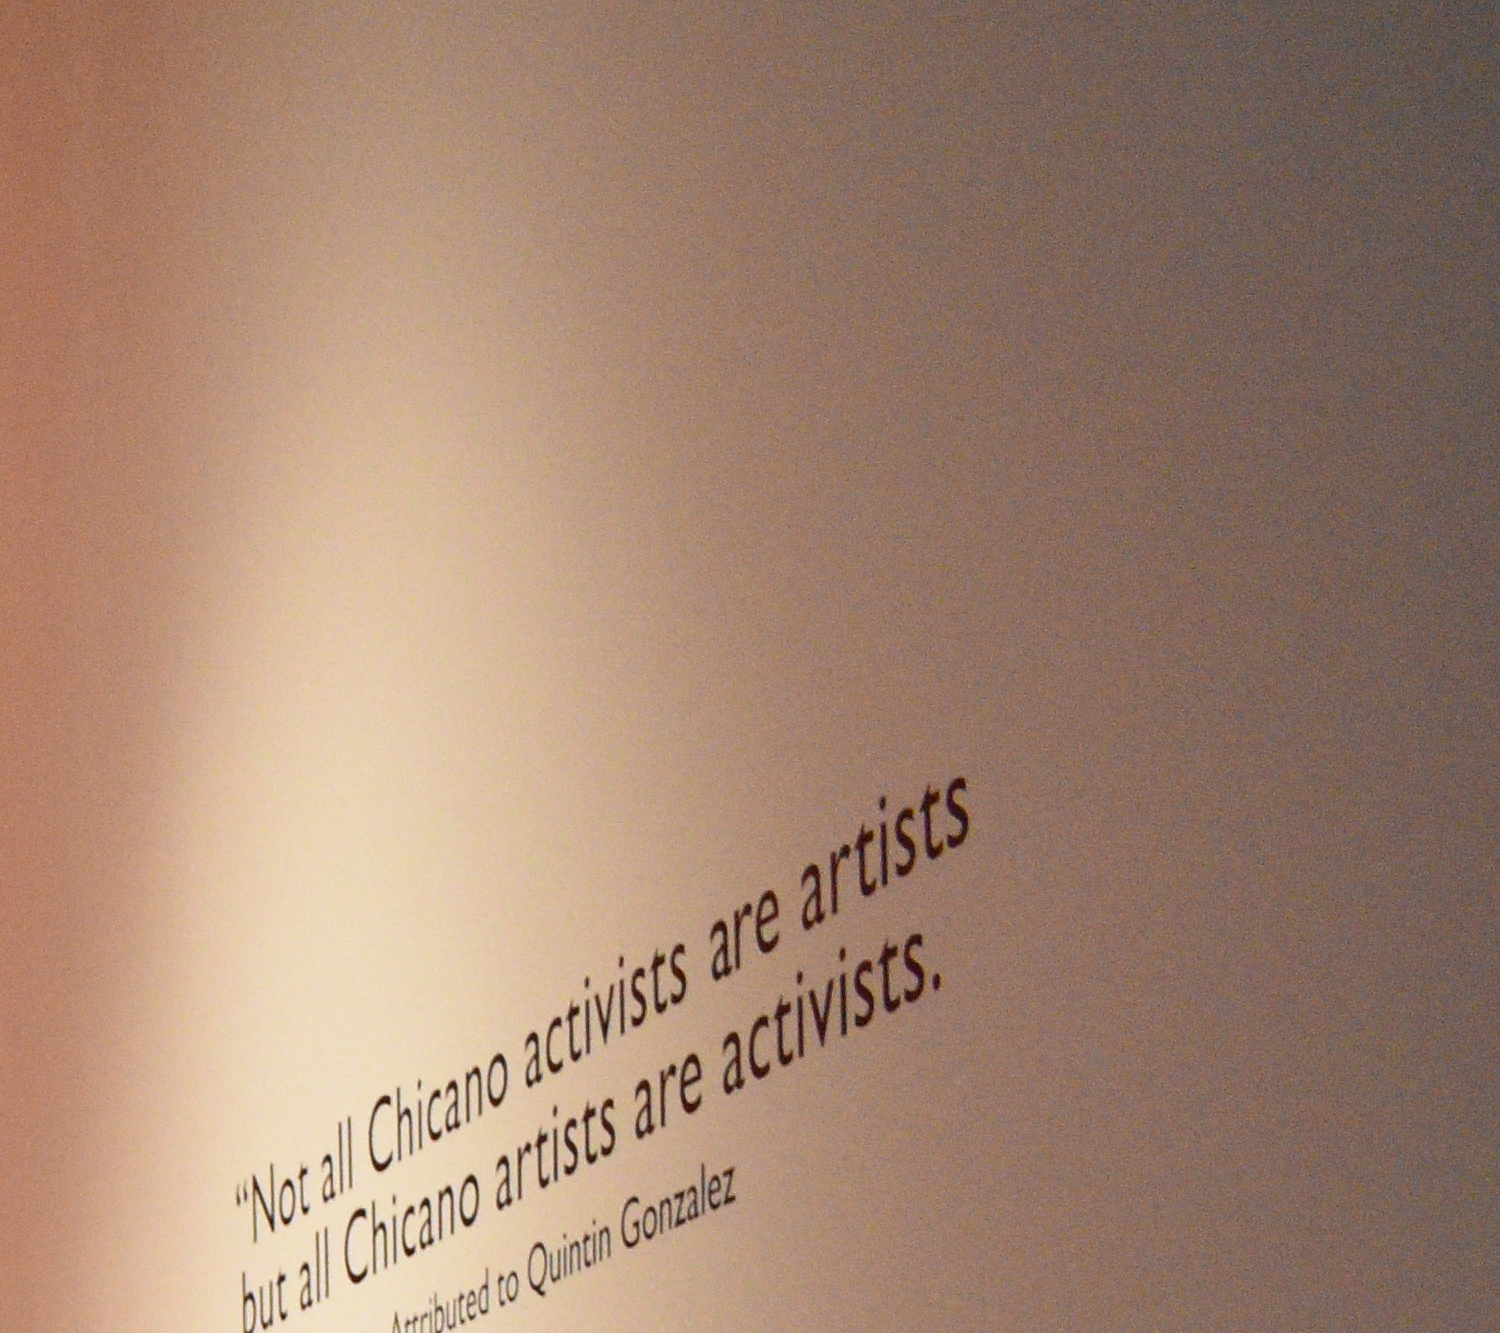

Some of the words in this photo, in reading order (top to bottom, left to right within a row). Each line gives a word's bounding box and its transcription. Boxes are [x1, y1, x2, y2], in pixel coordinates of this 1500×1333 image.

[299, 1227, 330, 1311] all
[344, 1174, 480, 1284] Chicano
[495, 1097, 616, 1211] artists
[634, 1053, 702, 1140] are
[722, 933, 942, 1095] activists.
[321, 1116, 353, 1204] all
[368, 1053, 508, 1172] Chicano
[525, 943, 687, 1088] activists
[709, 890, 780, 981] are
[801, 777, 969, 931] artists
[497, 1270, 520, 1307] to
[528, 1220, 611, 1297] Quintin
[621, 1163, 736, 1249] Gonzalez
